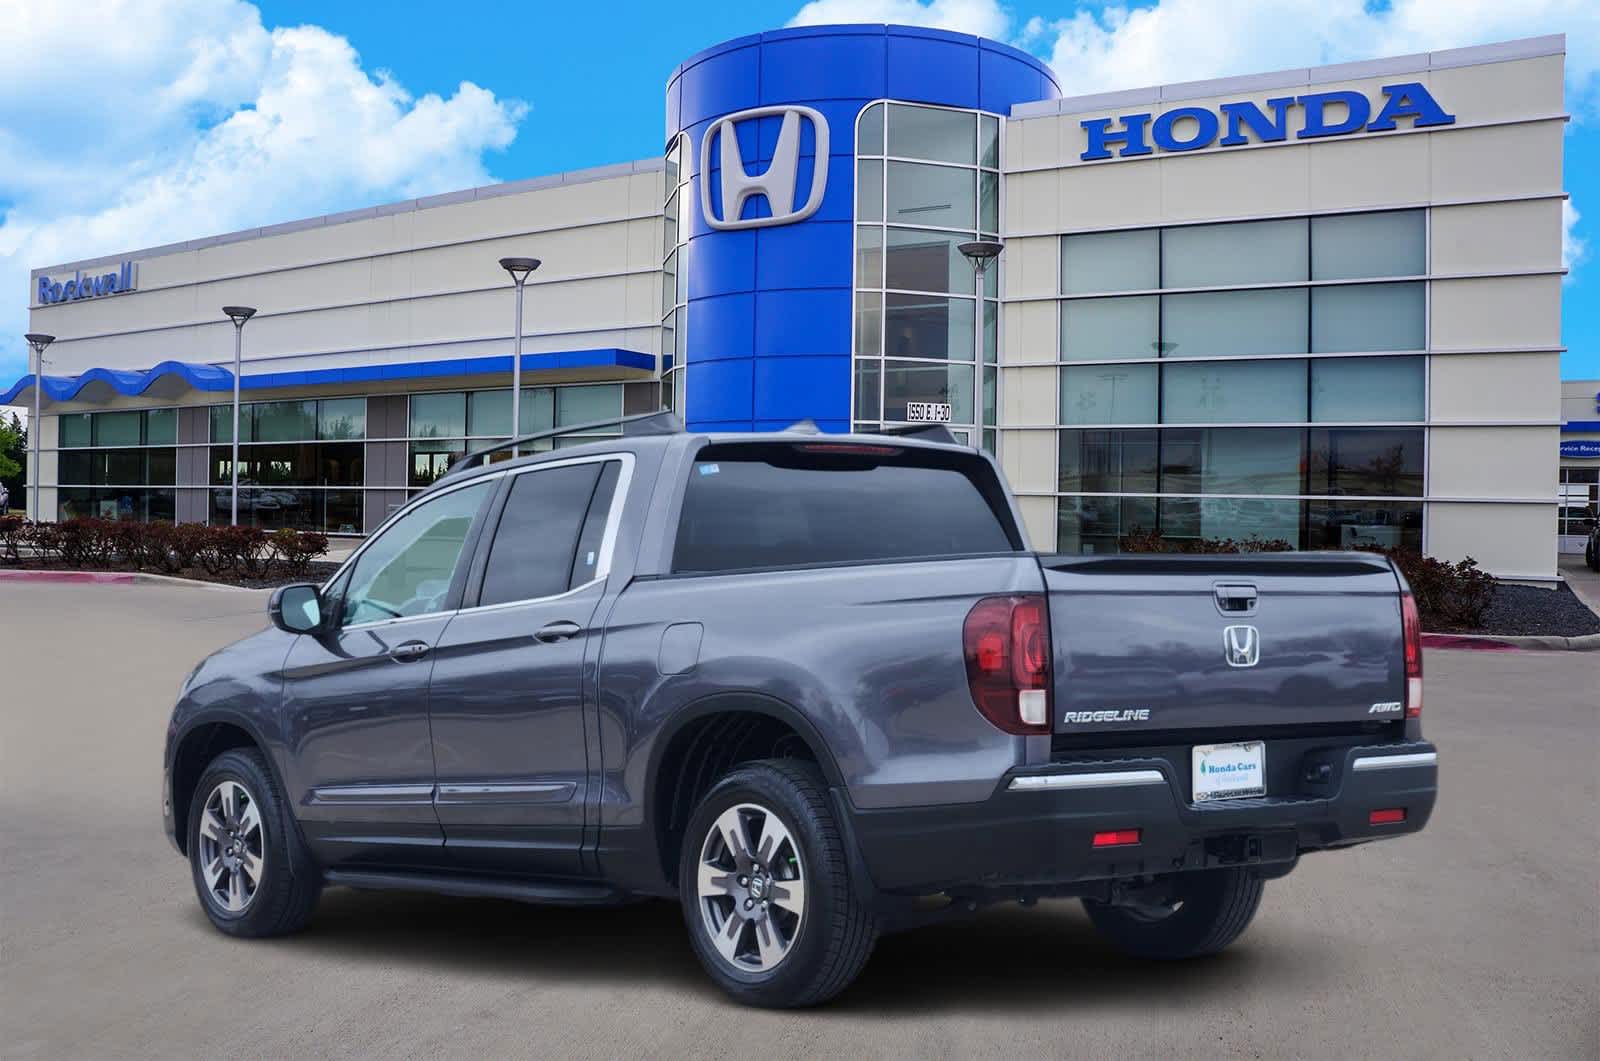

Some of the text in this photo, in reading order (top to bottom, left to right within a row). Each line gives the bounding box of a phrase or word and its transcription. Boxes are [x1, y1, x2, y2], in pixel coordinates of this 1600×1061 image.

[1080, 82, 1456, 161] HONDA
[38, 260, 133, 304] Rockwall
[908, 403, 925, 420] 1550
[934, 404, 950, 421] I-30
[1064, 709, 1150, 723] RIDGELINE
[1208, 763, 1256, 774] Honda Cars
